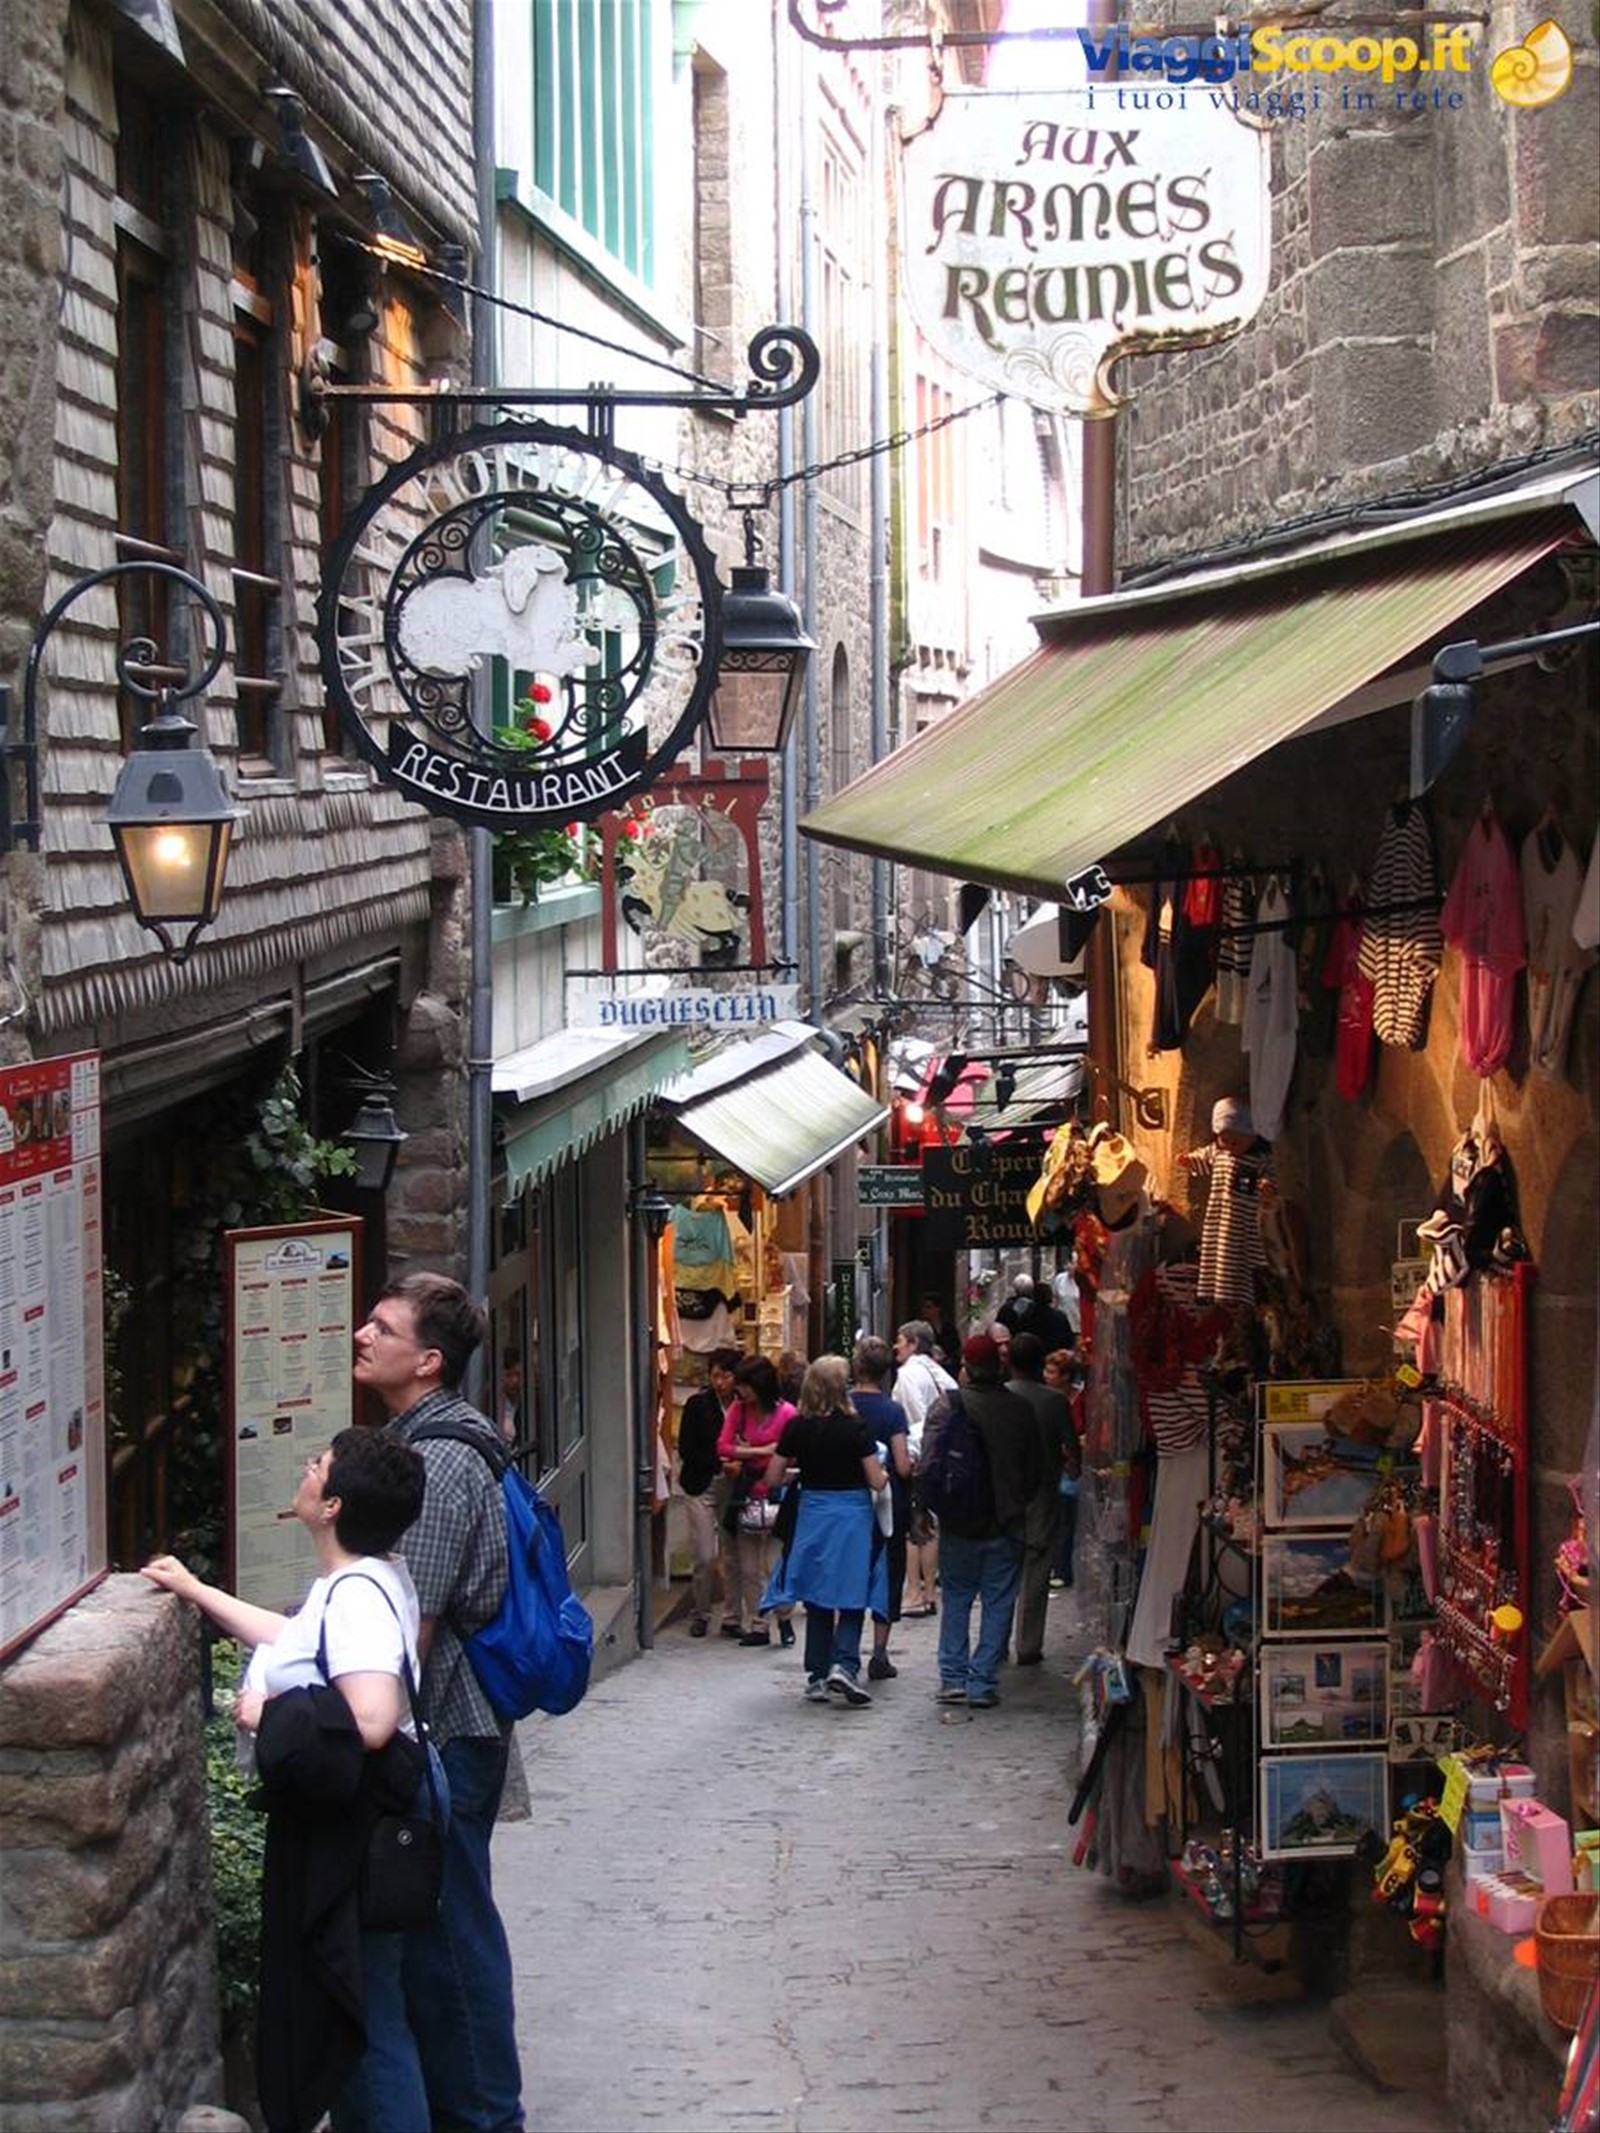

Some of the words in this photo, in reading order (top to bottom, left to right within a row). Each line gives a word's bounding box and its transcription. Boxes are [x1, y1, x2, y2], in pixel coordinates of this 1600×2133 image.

[1015, 121, 1140, 174] AUX
[926, 167, 1212, 255] ARMES
[399, 743, 629, 811] RESTAURANT
[930, 1185, 961, 1208] du
